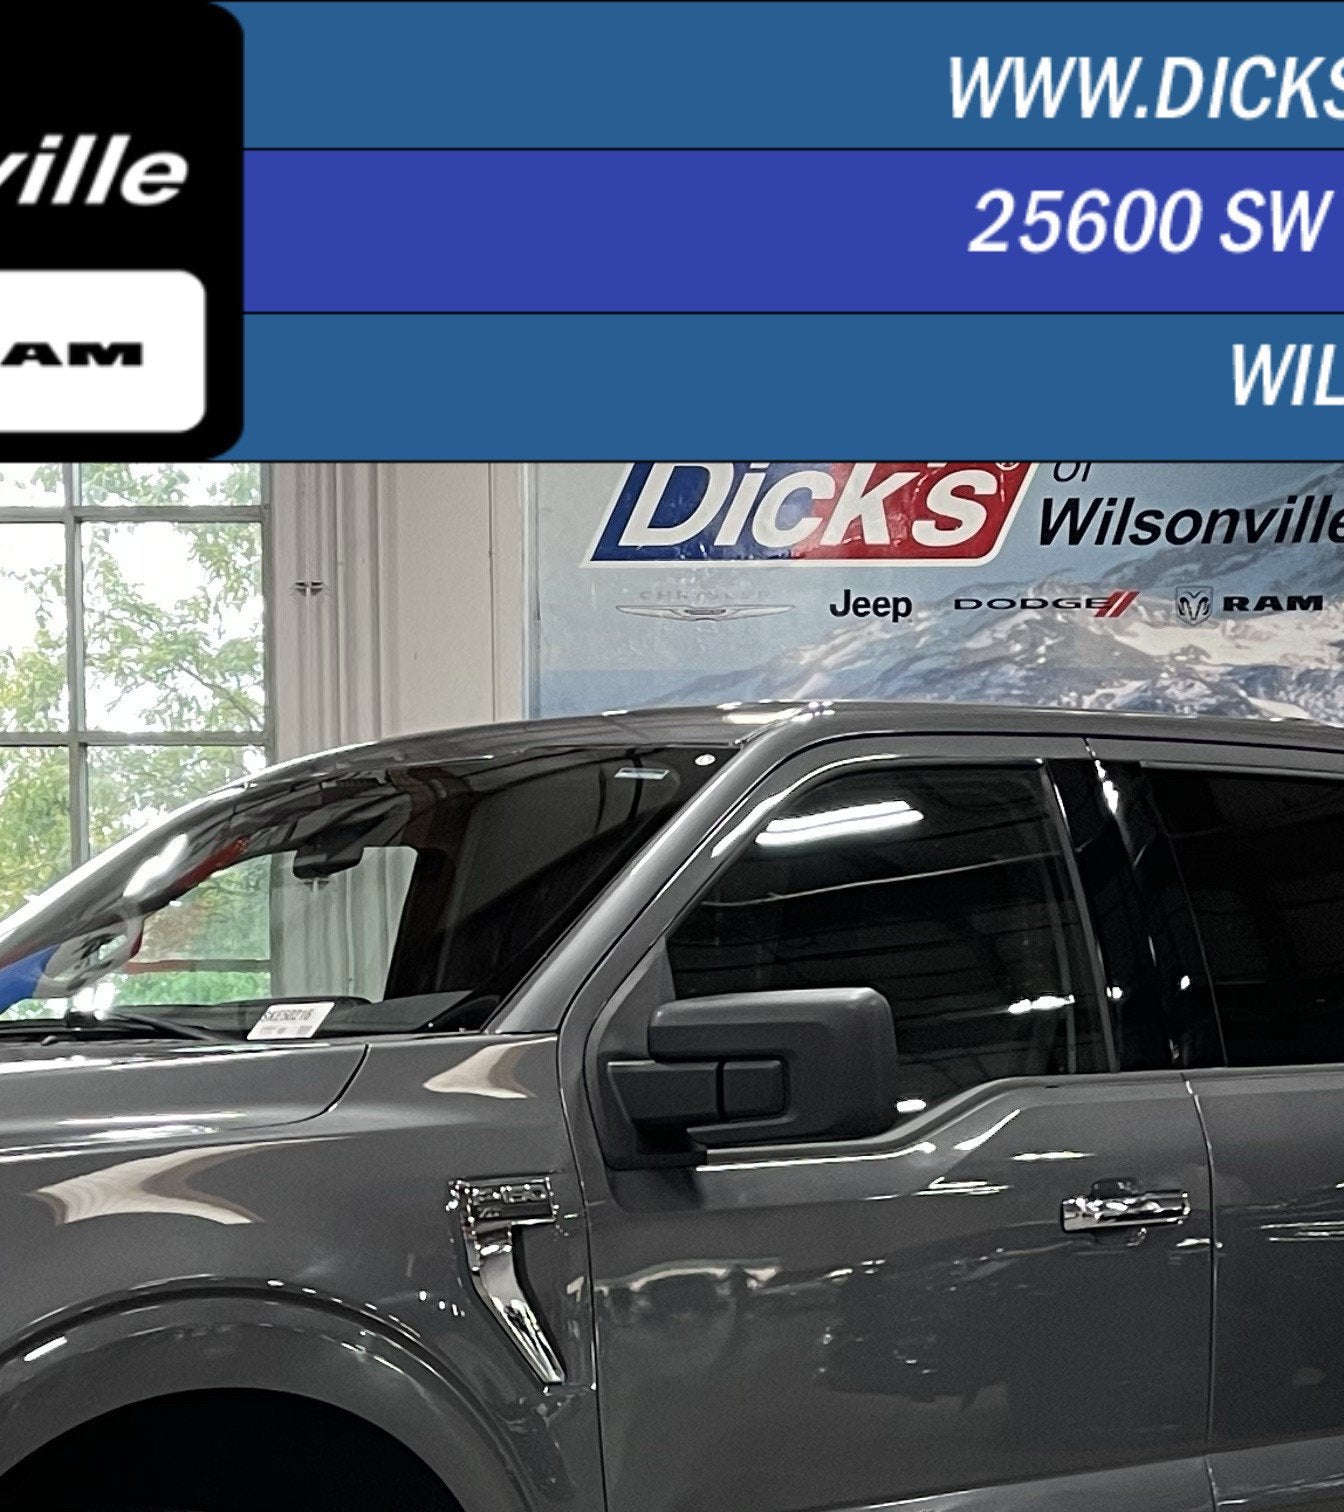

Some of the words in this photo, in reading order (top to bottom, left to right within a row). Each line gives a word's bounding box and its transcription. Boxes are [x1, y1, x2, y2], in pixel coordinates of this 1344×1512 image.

[619, 462, 998, 547] Dicks
[829, 588, 913, 623] Jeep
[954, 597, 1113, 611] DODGE
[1222, 595, 1324, 612] RAM
